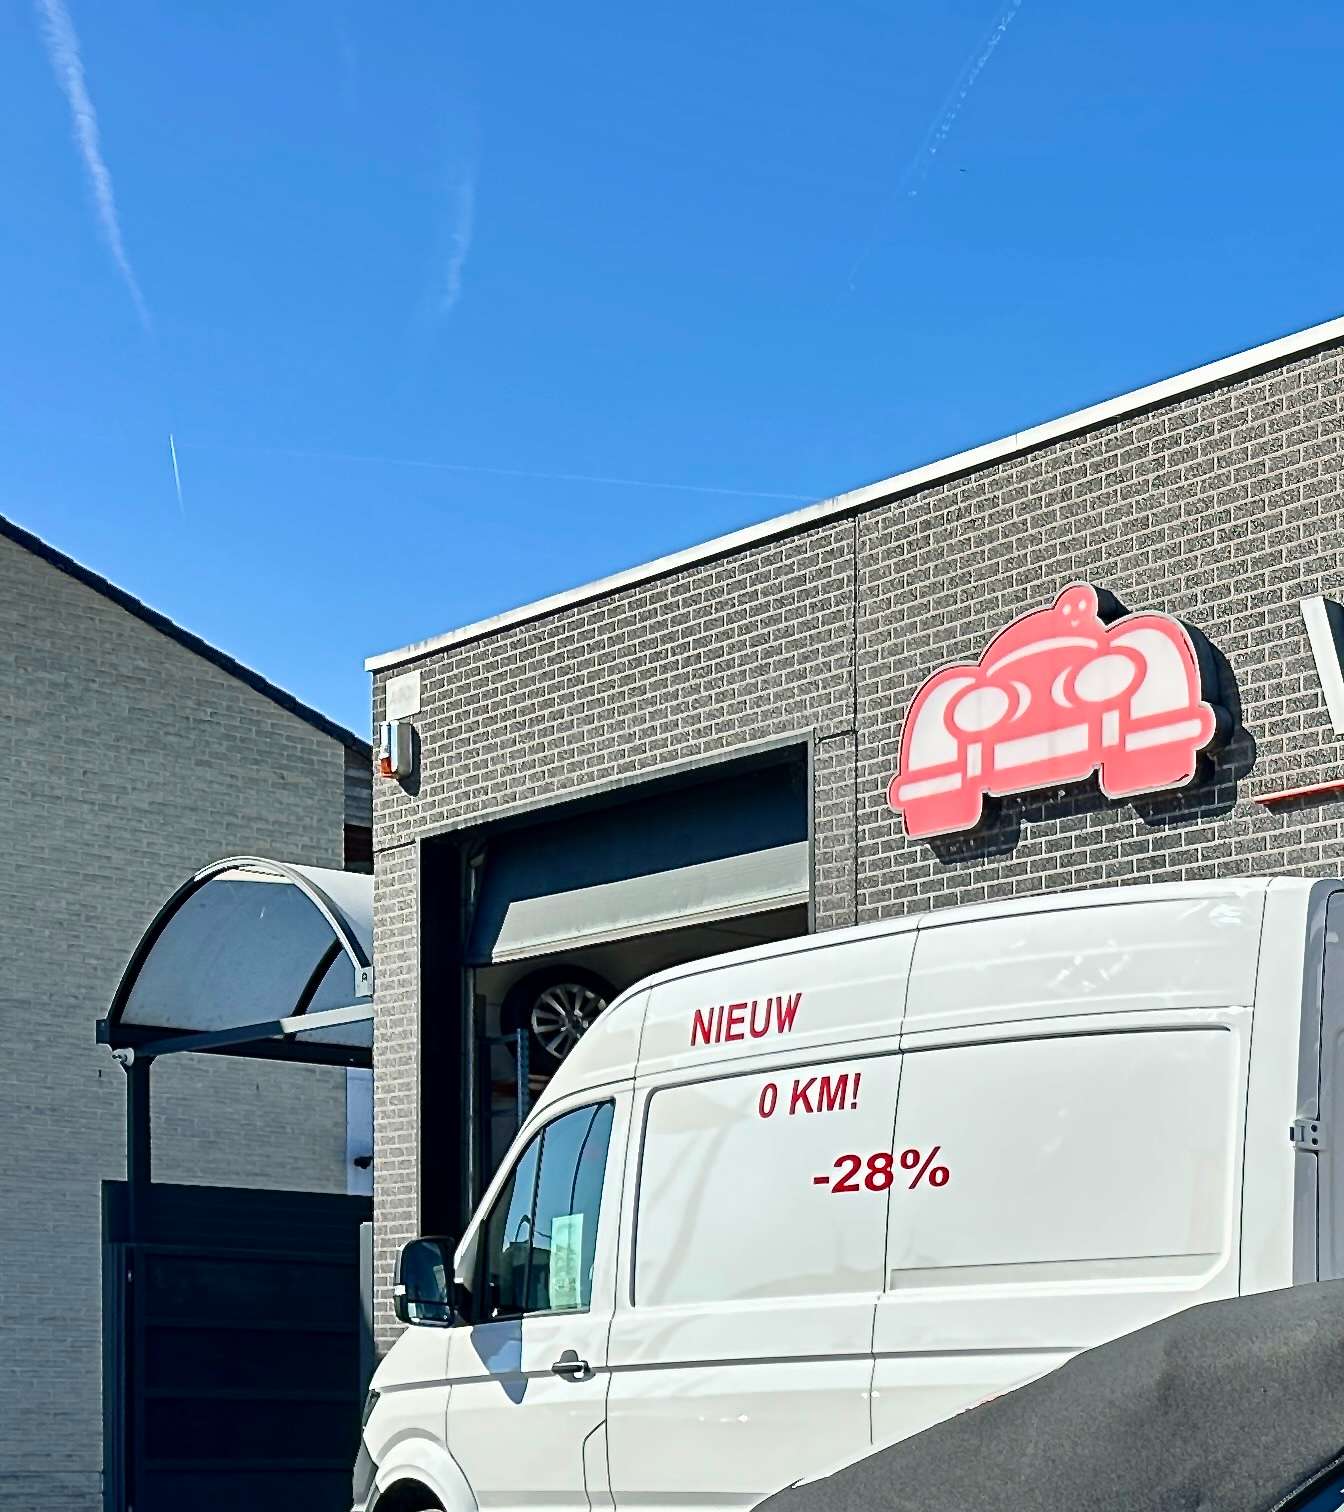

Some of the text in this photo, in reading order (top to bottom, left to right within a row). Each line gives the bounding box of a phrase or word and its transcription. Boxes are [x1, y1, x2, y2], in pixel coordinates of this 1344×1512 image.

[690, 992, 802, 1047] NIEUW
[758, 1072, 862, 1119] 0 KM!
[813, 1146, 950, 1194] -28%
